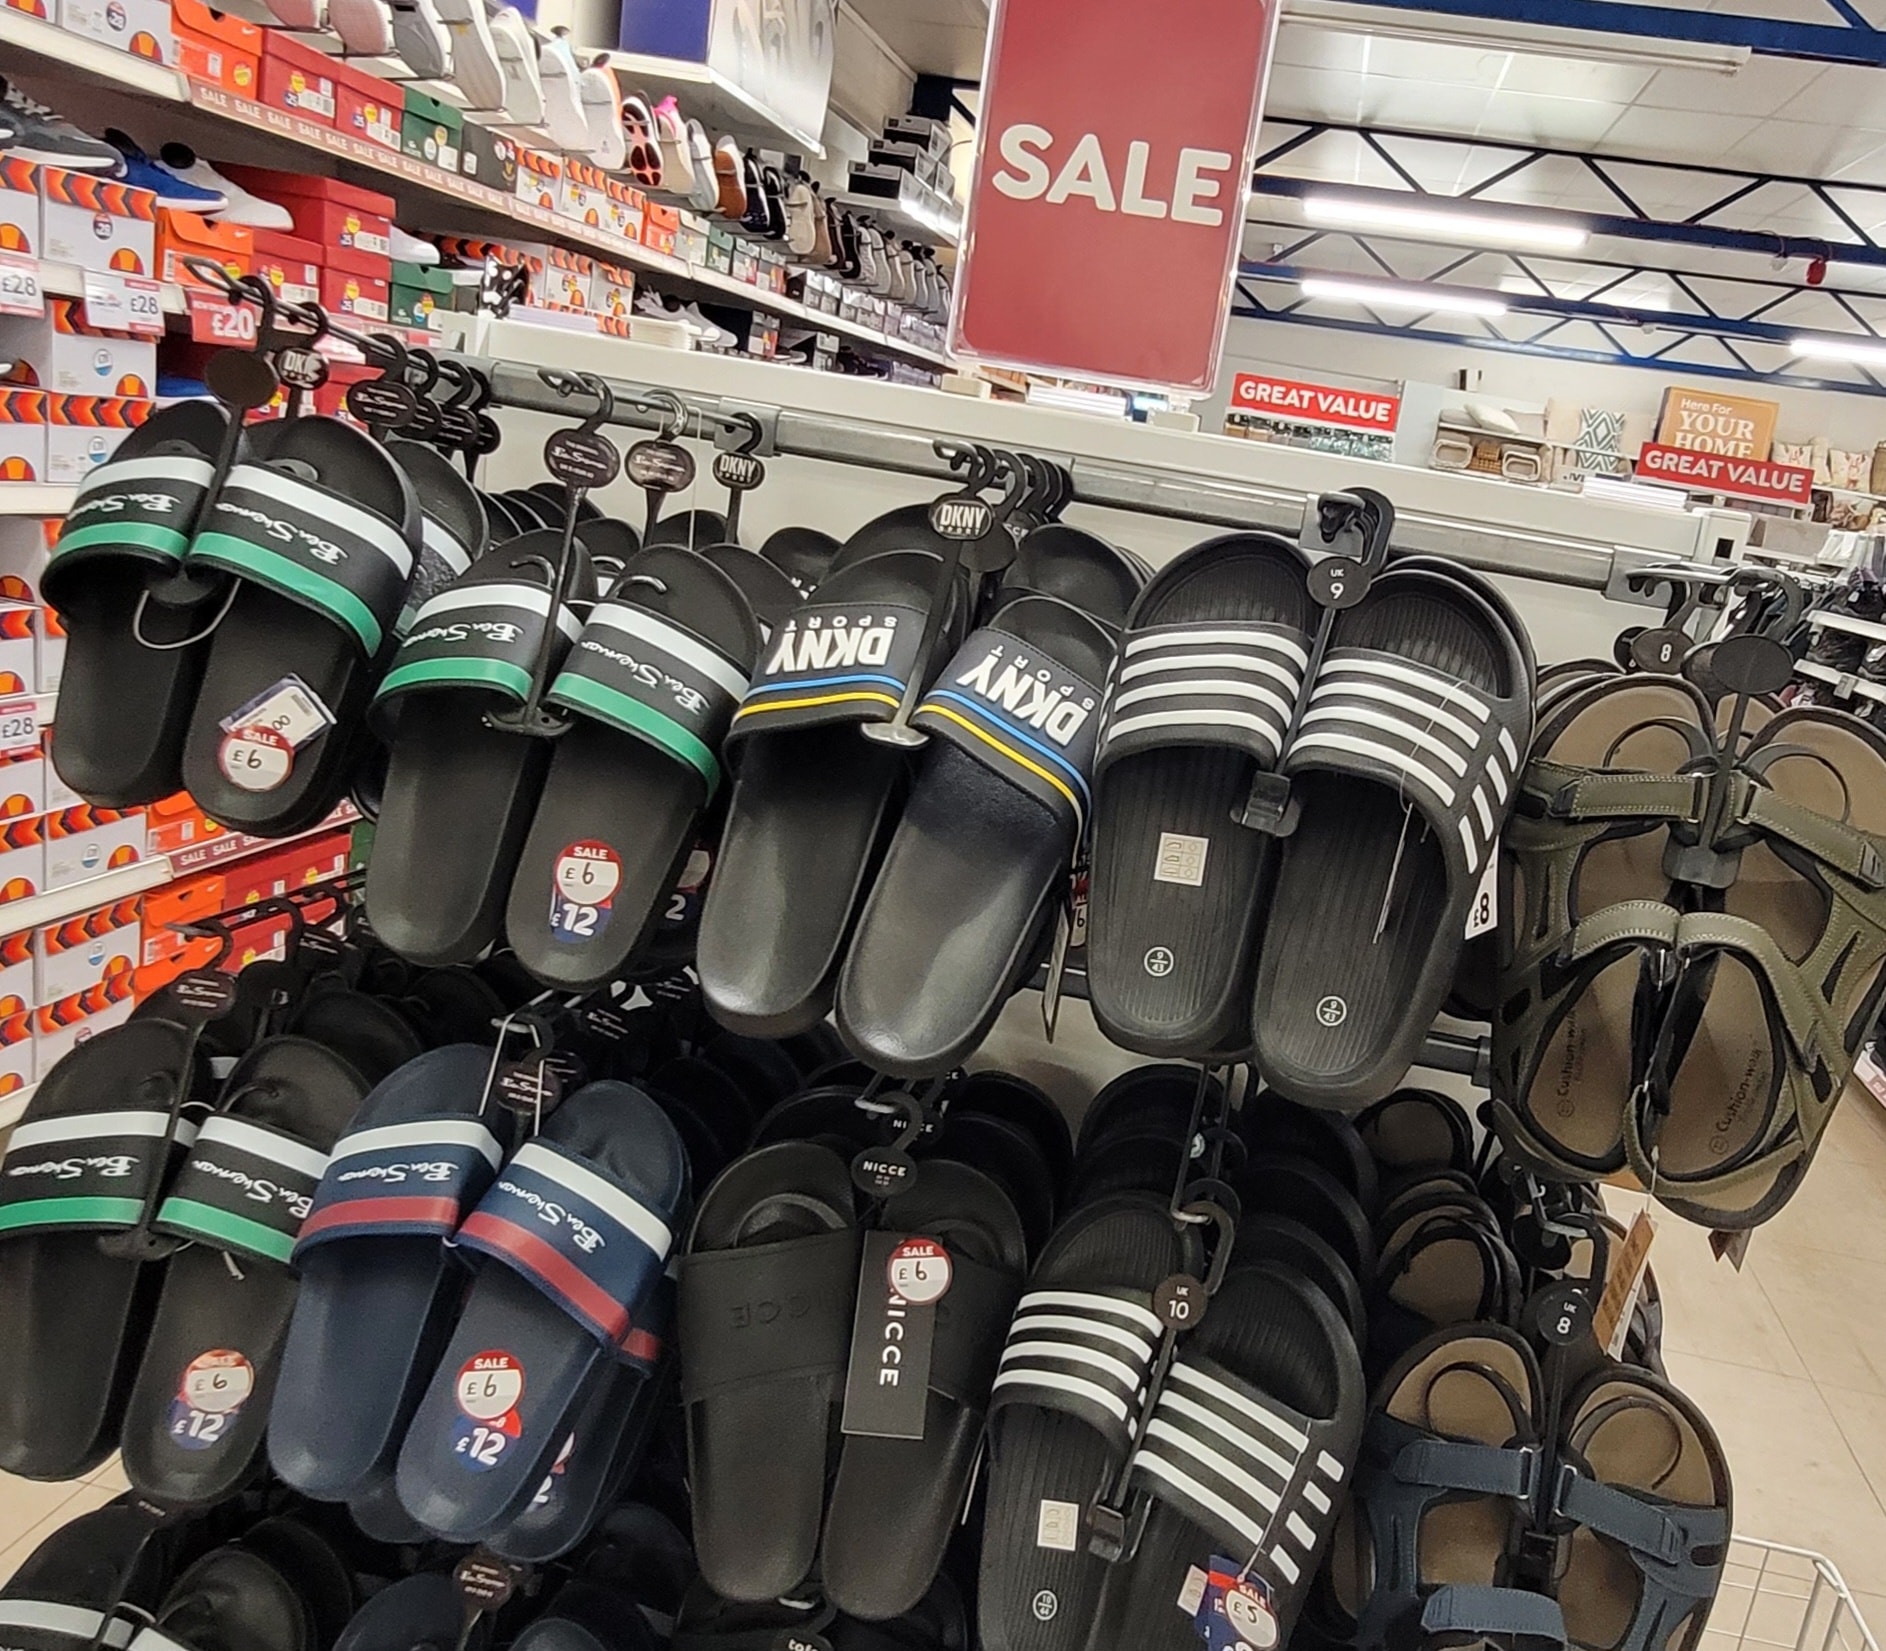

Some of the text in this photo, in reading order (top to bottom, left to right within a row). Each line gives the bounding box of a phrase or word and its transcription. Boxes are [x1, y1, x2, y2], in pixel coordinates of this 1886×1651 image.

[200, 87, 227, 107] SALE
[235, 99, 261, 119] SALE
[267, 111, 292, 130] SALE
[325, 133, 348, 150] SALE
[992, 124, 1232, 227] SALE
[2, 274, 37, 298] £28
[130, 296, 159, 316] £28
[211, 307, 255, 340] £20
[1239, 381, 1392, 422] GREAT VALUE
[1681, 398, 1732, 416] Here For
[1679, 411, 1755, 440] YOUR
[1674, 432, 1754, 462] HOME
[719, 454, 758, 478] DKNY
[1644, 450, 1806, 493] GREAT VALUE
[940, 504, 987, 529] DKNY
[297, 529, 349, 566] Ben
[1330, 568, 1345, 577] UK
[1330, 583, 1344, 600] 9
[472, 622, 524, 643] Ben
[784, 615, 898, 633] SPORT
[765, 627, 895, 676] DKNY
[1660, 643, 1672, 662] 8
[990, 644, 1096, 711] SPORT
[664, 674, 711, 716] Ben
[954, 654, 1089, 748] DKNY
[2, 717, 35, 738] £28
[242, 730, 279, 746] SALE
[180, 849, 207, 866] SALE
[212, 839, 237, 856] SALE
[573, 846, 608, 860] SALE
[551, 903, 598, 936] £12
[1473, 892, 1489, 928] £8
[86, 1155, 141, 1177] Ben
[410, 1161, 460, 1182] Ben
[863, 1160, 907, 1177] NICCE
[566, 1212, 606, 1254] Ben
[902, 1246, 934, 1257] SALE
[1176, 1286, 1189, 1297] UK
[1168, 1300, 1189, 1320] 10
[1563, 1302, 1577, 1314] UK
[879, 1287, 907, 1386] NICCE
[1556, 1316, 1571, 1335] 8
[474, 1357, 509, 1370] SALE
[172, 1410, 225, 1442] £12
[455, 1427, 506, 1466] £12
